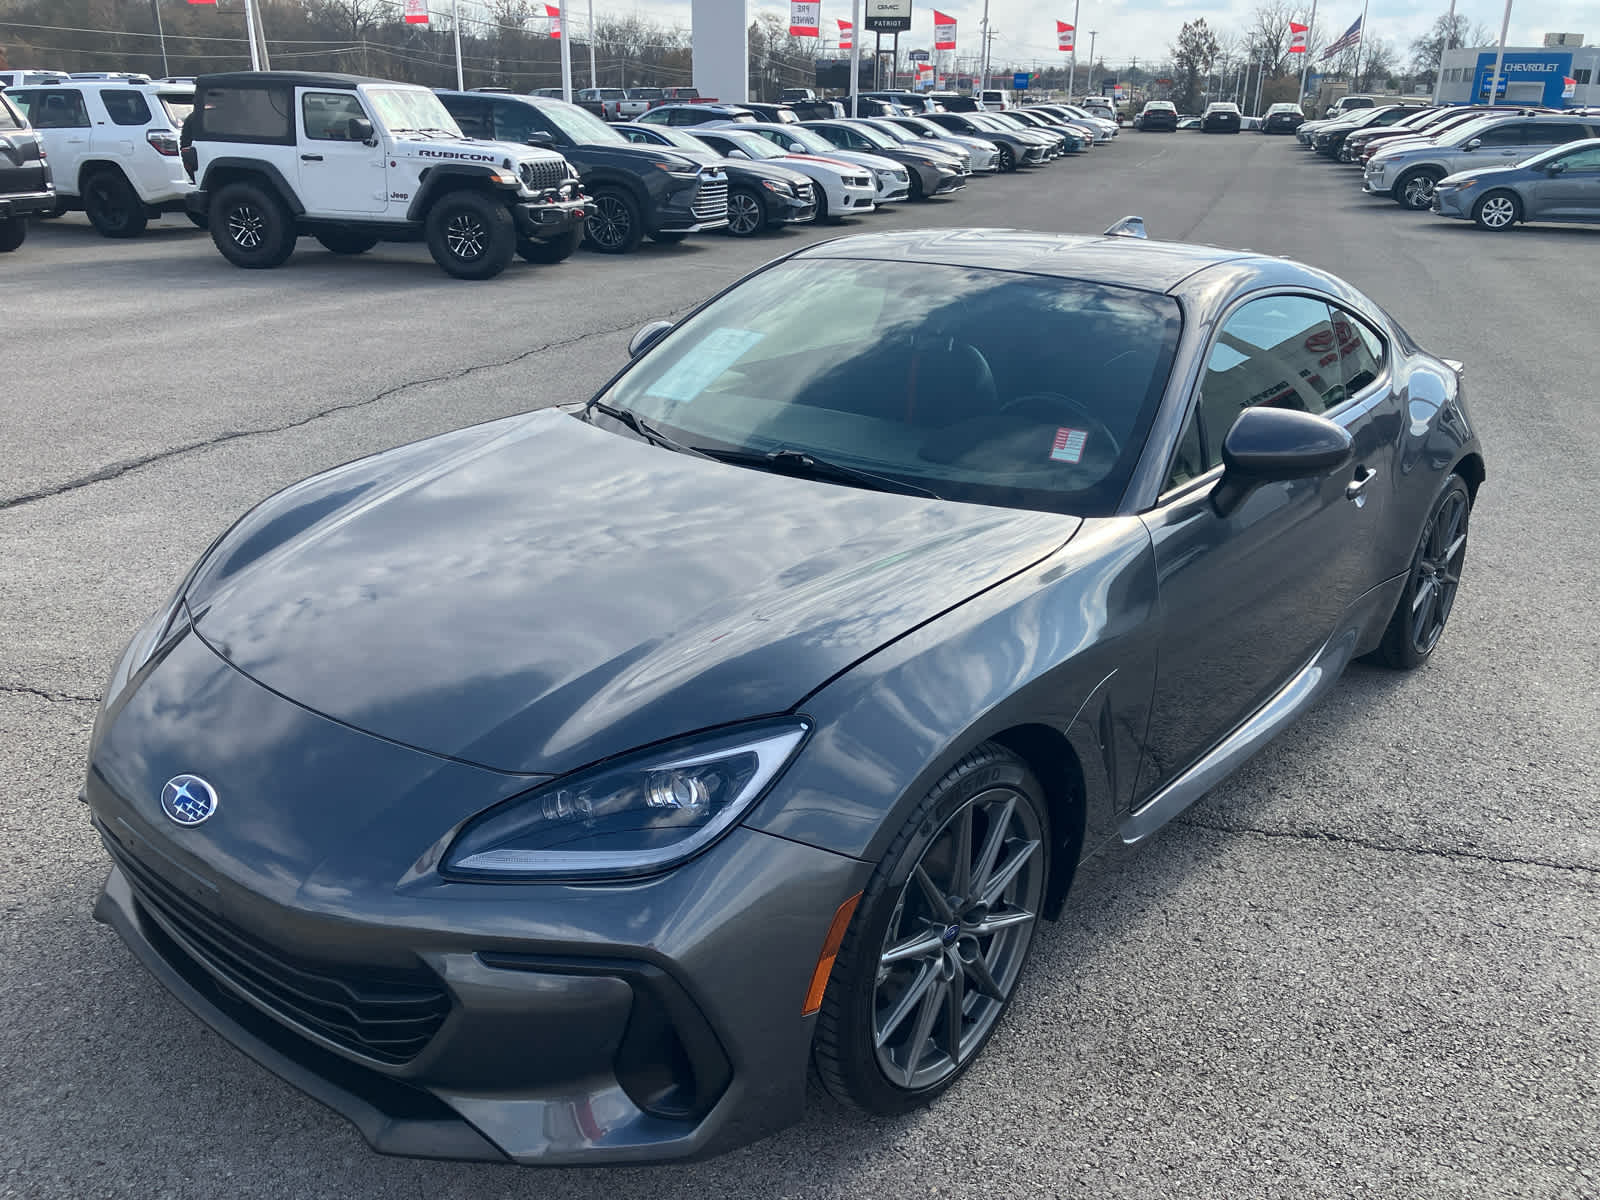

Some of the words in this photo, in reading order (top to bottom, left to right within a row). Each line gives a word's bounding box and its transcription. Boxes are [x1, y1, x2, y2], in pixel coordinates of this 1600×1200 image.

[1504, 64, 1559, 72] CHEVROLET
[419, 150, 495, 161] RUBICON
[390, 191, 409, 200] Jeep
